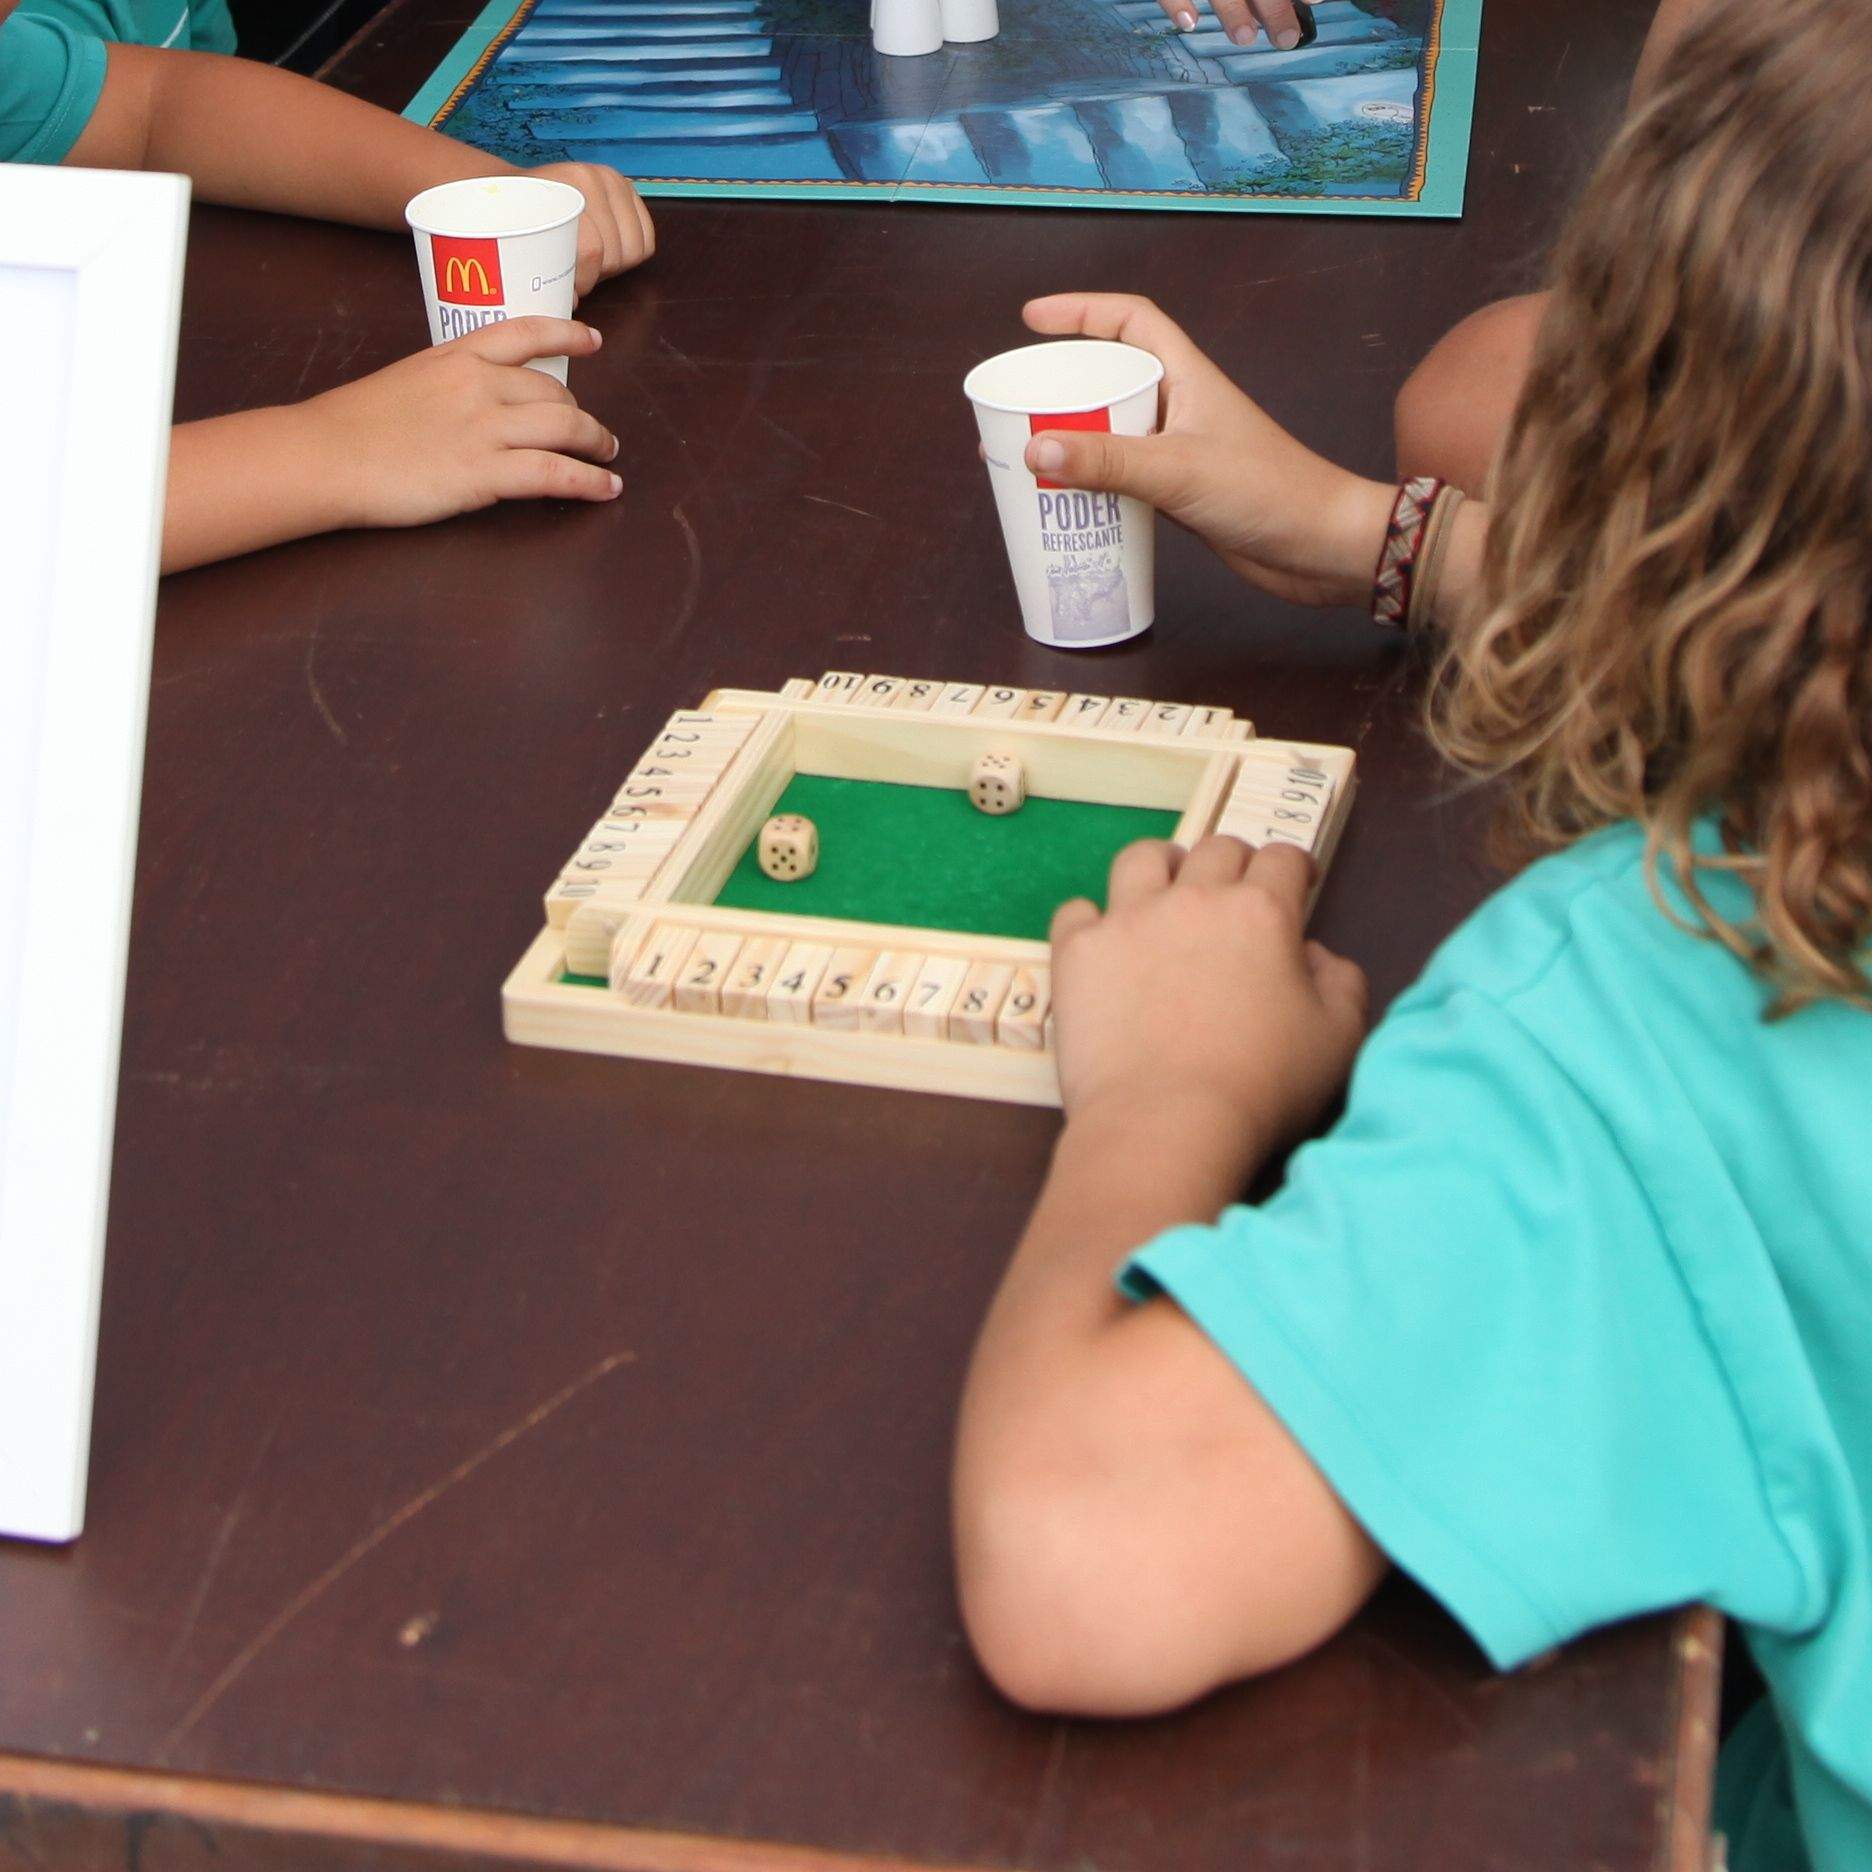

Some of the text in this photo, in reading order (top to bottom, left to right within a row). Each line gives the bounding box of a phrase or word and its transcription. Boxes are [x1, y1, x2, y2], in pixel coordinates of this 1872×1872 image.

[1038, 490, 1122, 530] PODER
[1040, 526, 1124, 553] REFRESCANTE
[822, 672, 1217, 725] 1 2 3 4 5 6 7 8 9 10
[559, 715, 714, 898] 1 2 3 4 5 6 7 8 9 10
[1266, 768, 1328, 842] 7 8 9 10
[646, 954, 1037, 1016] 1 2 3 4 5 6 7 8 9
